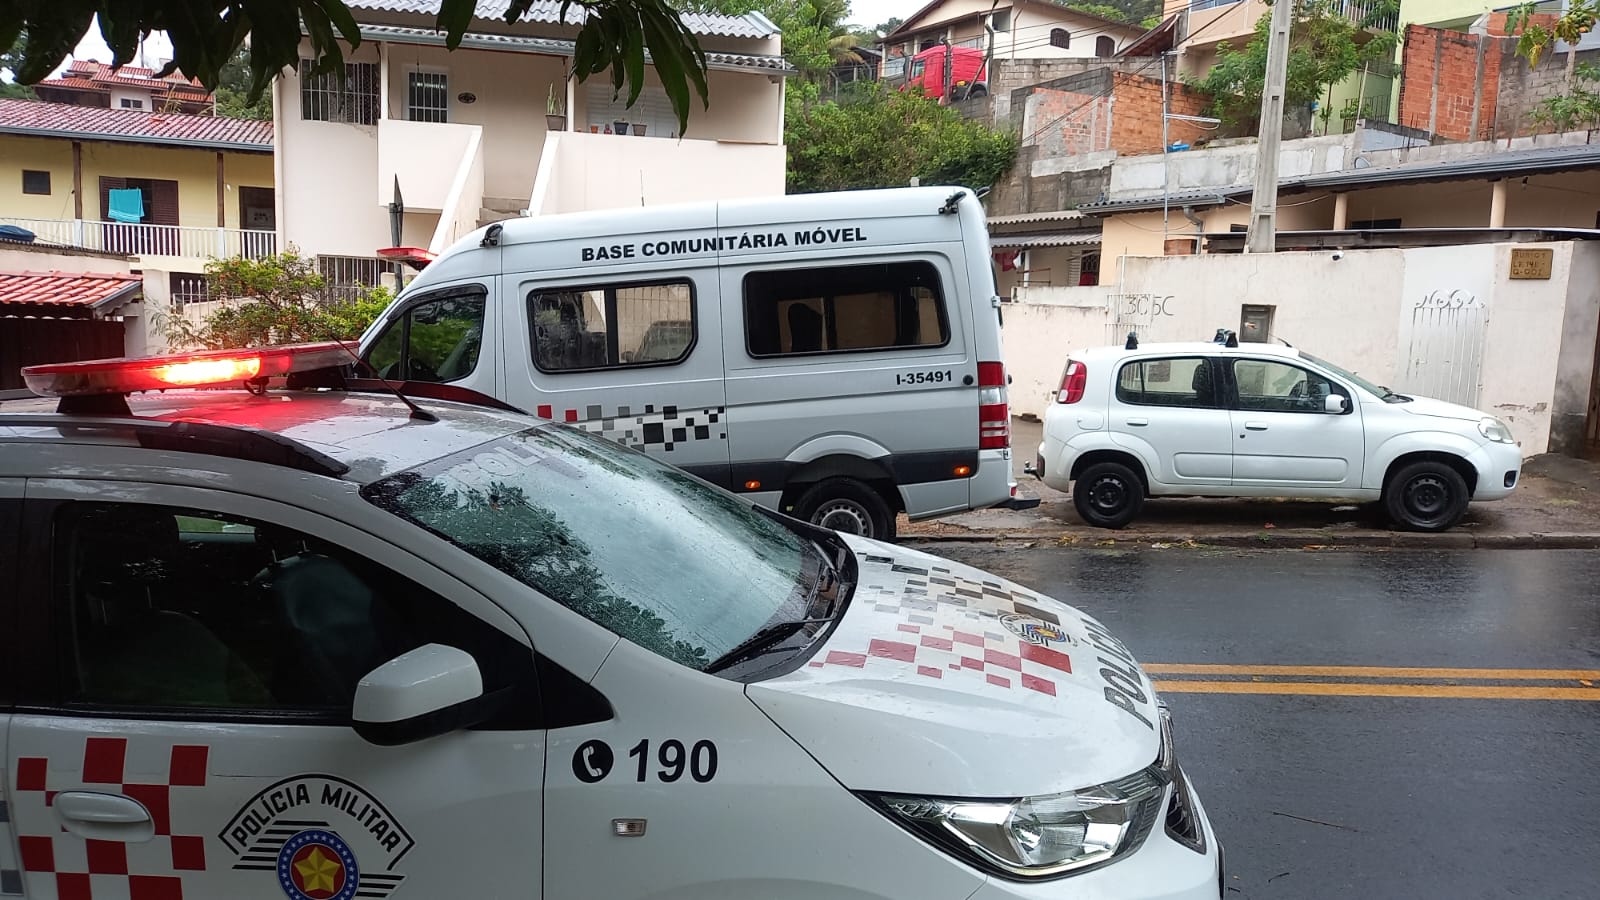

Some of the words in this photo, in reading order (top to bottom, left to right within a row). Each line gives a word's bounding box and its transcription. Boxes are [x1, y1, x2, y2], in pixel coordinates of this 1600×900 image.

[581, 244, 636, 262] BASE
[642, 232, 788, 257] COMUNITÁRIA
[794, 227, 867, 246] MÓVEL
[896, 370, 952, 385] I-35491
[629, 738, 718, 783] 190
[231, 783, 311, 847] POLÍCIA
[320, 783, 401, 853] MILITAR
